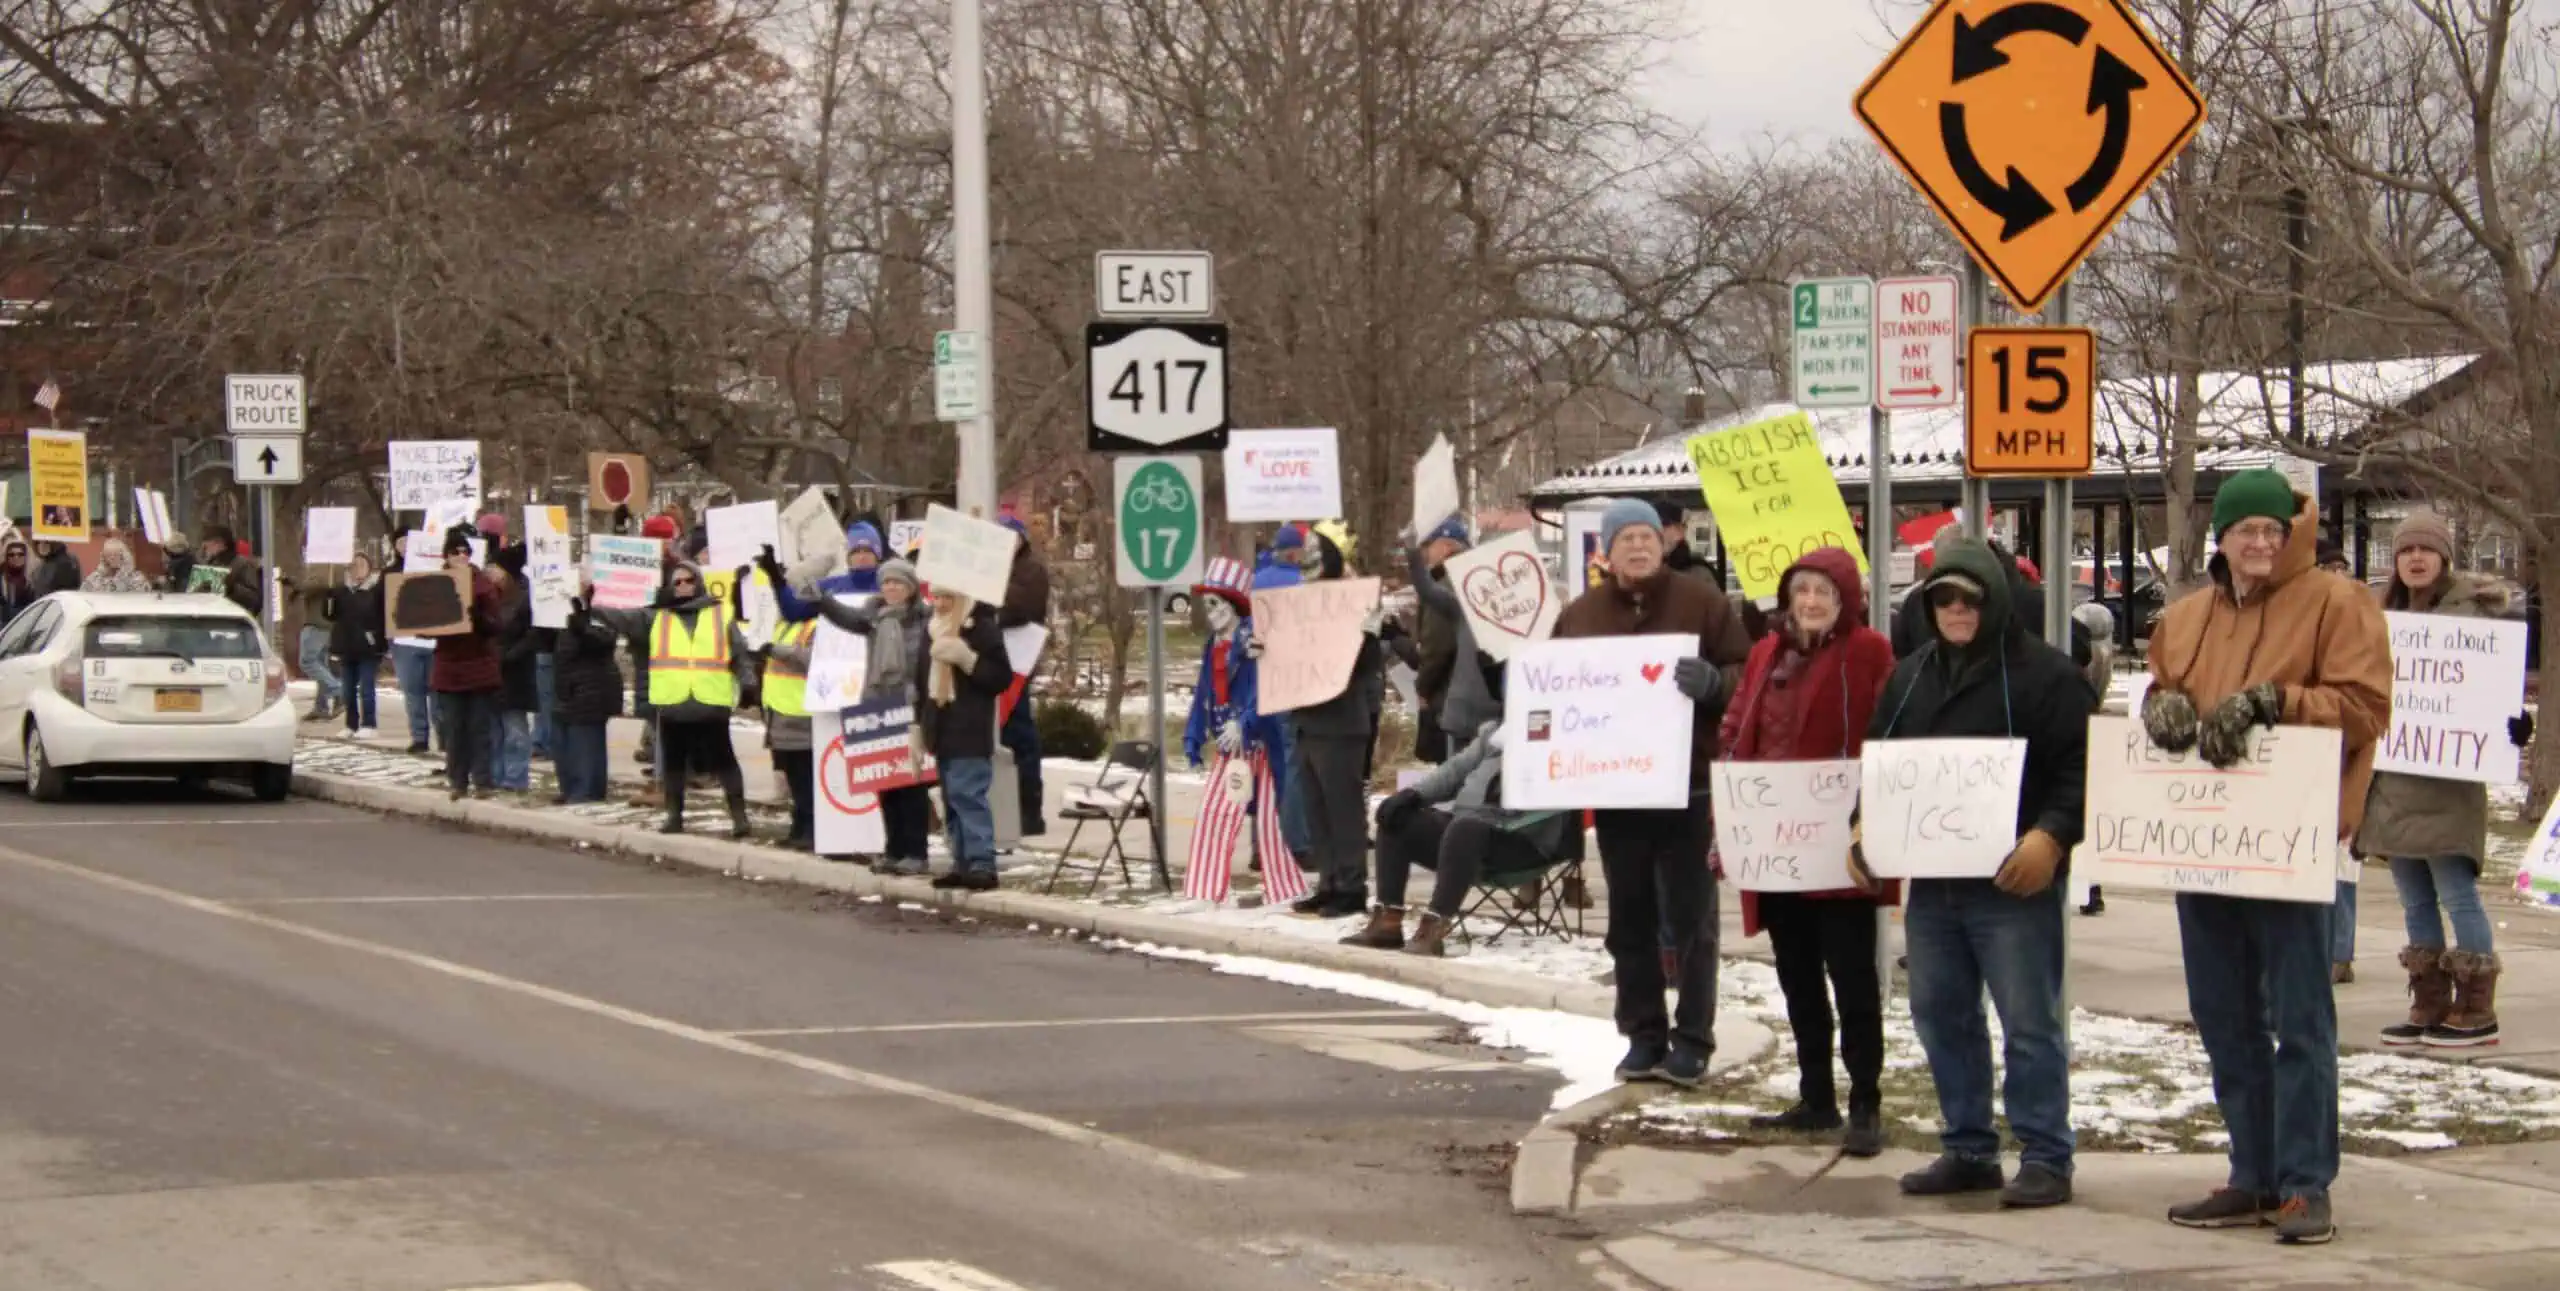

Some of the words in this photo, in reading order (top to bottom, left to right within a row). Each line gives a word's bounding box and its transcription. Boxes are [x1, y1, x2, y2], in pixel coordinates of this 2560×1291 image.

[1118, 264, 1192, 304] EAST
[1799, 289, 1814, 323] 2
[1833, 286, 1854, 302] HR
[1819, 304, 1868, 321] PARKING
[1901, 290, 1931, 315] NO
[1881, 319, 1951, 338] STANDING
[1901, 343, 1930, 360] ANY
[1108, 359, 1208, 414] 417
[1899, 365, 1933, 384] TIME
[1990, 346, 2070, 414] 15
[232, 383, 296, 401] TRUCK
[235, 405, 299, 424] ROUTE
[1693, 422, 1814, 469] ABOLISH
[1995, 429, 2065, 456] MPH
[1261, 460, 1311, 478] LOVE
[1728, 460, 1789, 493] ICE
[1752, 493, 1792, 516] FOR
[1137, 527, 1183, 568] 17
[2443, 626, 2500, 654] about
[1522, 660, 1622, 694] Workers
[2394, 655, 2465, 684] LITICS
[2394, 692, 2456, 715] about
[1561, 704, 1612, 732] Over
[1877, 756, 1919, 795] NO
[1935, 754, 2013, 793] MORE
[1724, 774, 1781, 809] ICE
[2167, 780, 2232, 803] OUR
[1731, 825, 1753, 846] IS
[1775, 822, 1827, 845] NOT
[2095, 813, 2319, 864] DEMOCRACY!
[1740, 855, 1803, 881] NICE
